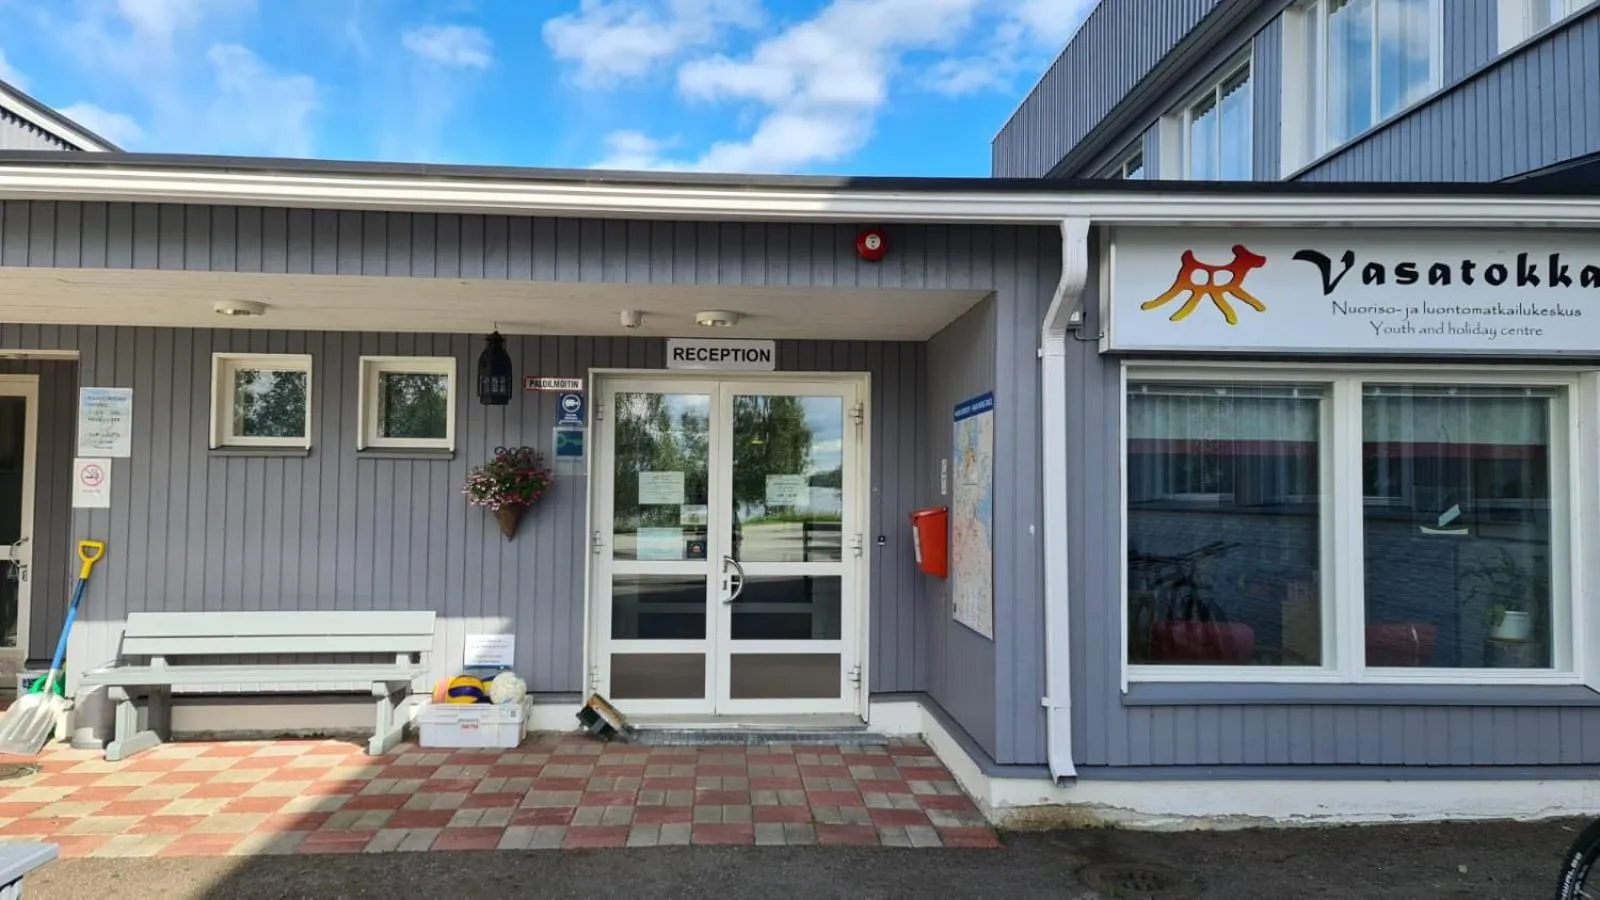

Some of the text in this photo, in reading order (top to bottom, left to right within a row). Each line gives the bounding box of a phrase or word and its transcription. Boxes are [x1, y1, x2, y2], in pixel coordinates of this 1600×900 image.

[1292, 249, 1600, 296] Vasatokka
[1332, 300, 1582, 321] Nuoriso- ja luontomatkailukeskus
[1369, 320, 1544, 340] Youth and holiday centre
[673, 347, 771, 363] RECEPTION
[529, 379, 579, 389] PALOILMOITIN
